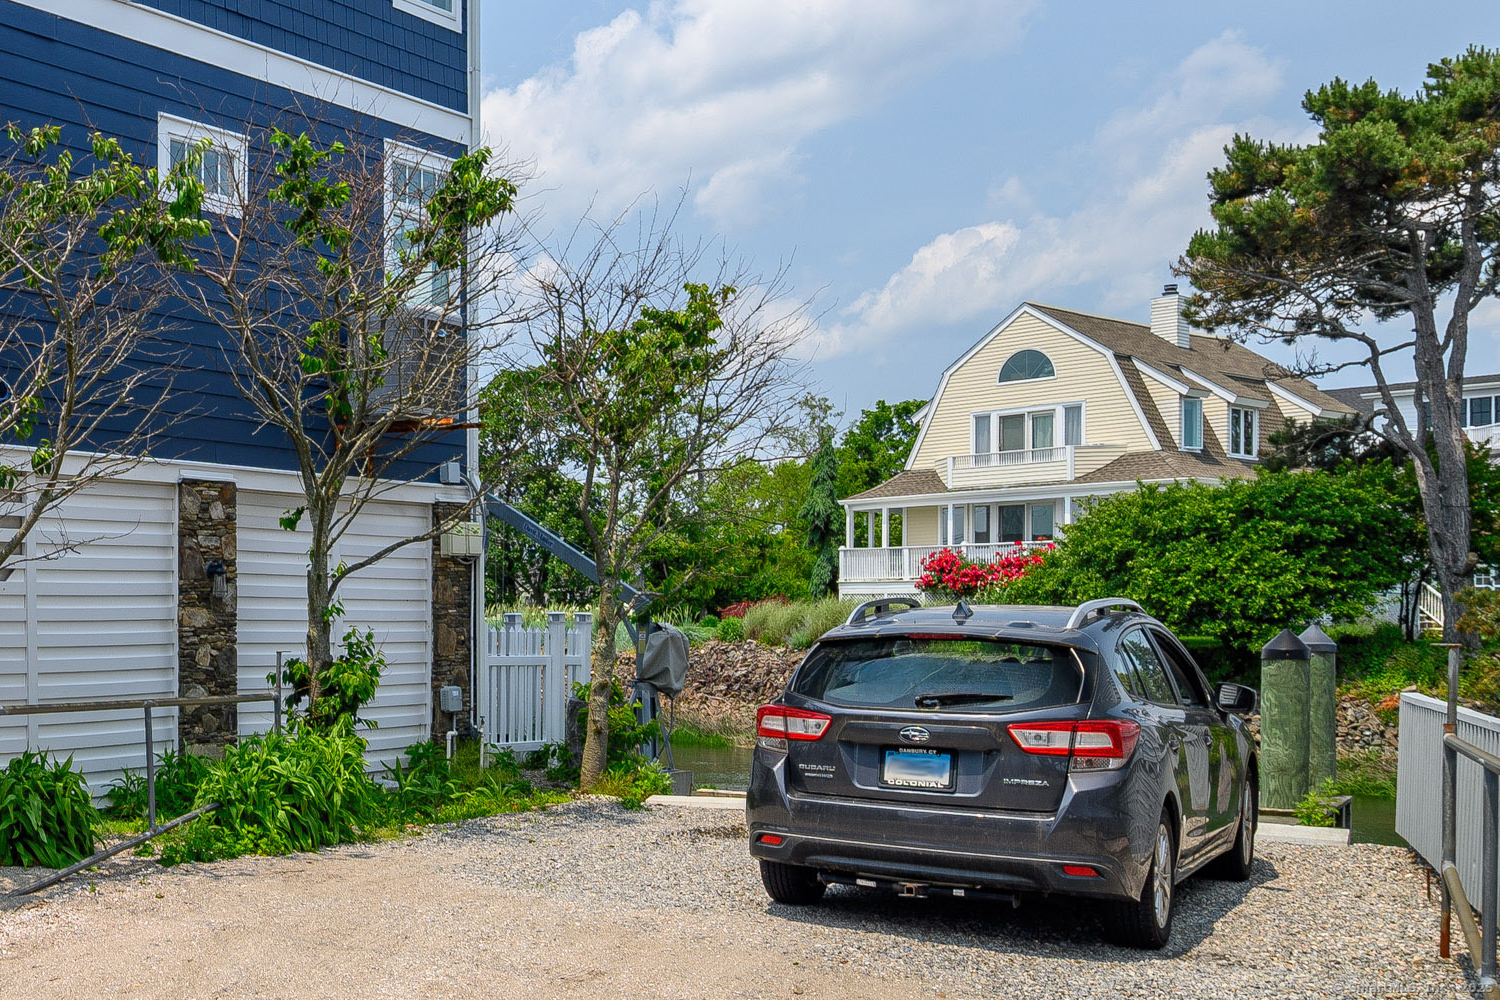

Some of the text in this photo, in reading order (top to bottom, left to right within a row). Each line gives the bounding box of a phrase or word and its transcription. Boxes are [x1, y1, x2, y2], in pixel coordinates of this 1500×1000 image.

[798, 763, 836, 772] SUBARU
[887, 779, 944, 788] COLONIAL
[1003, 777, 1050, 787] IMPREZA
